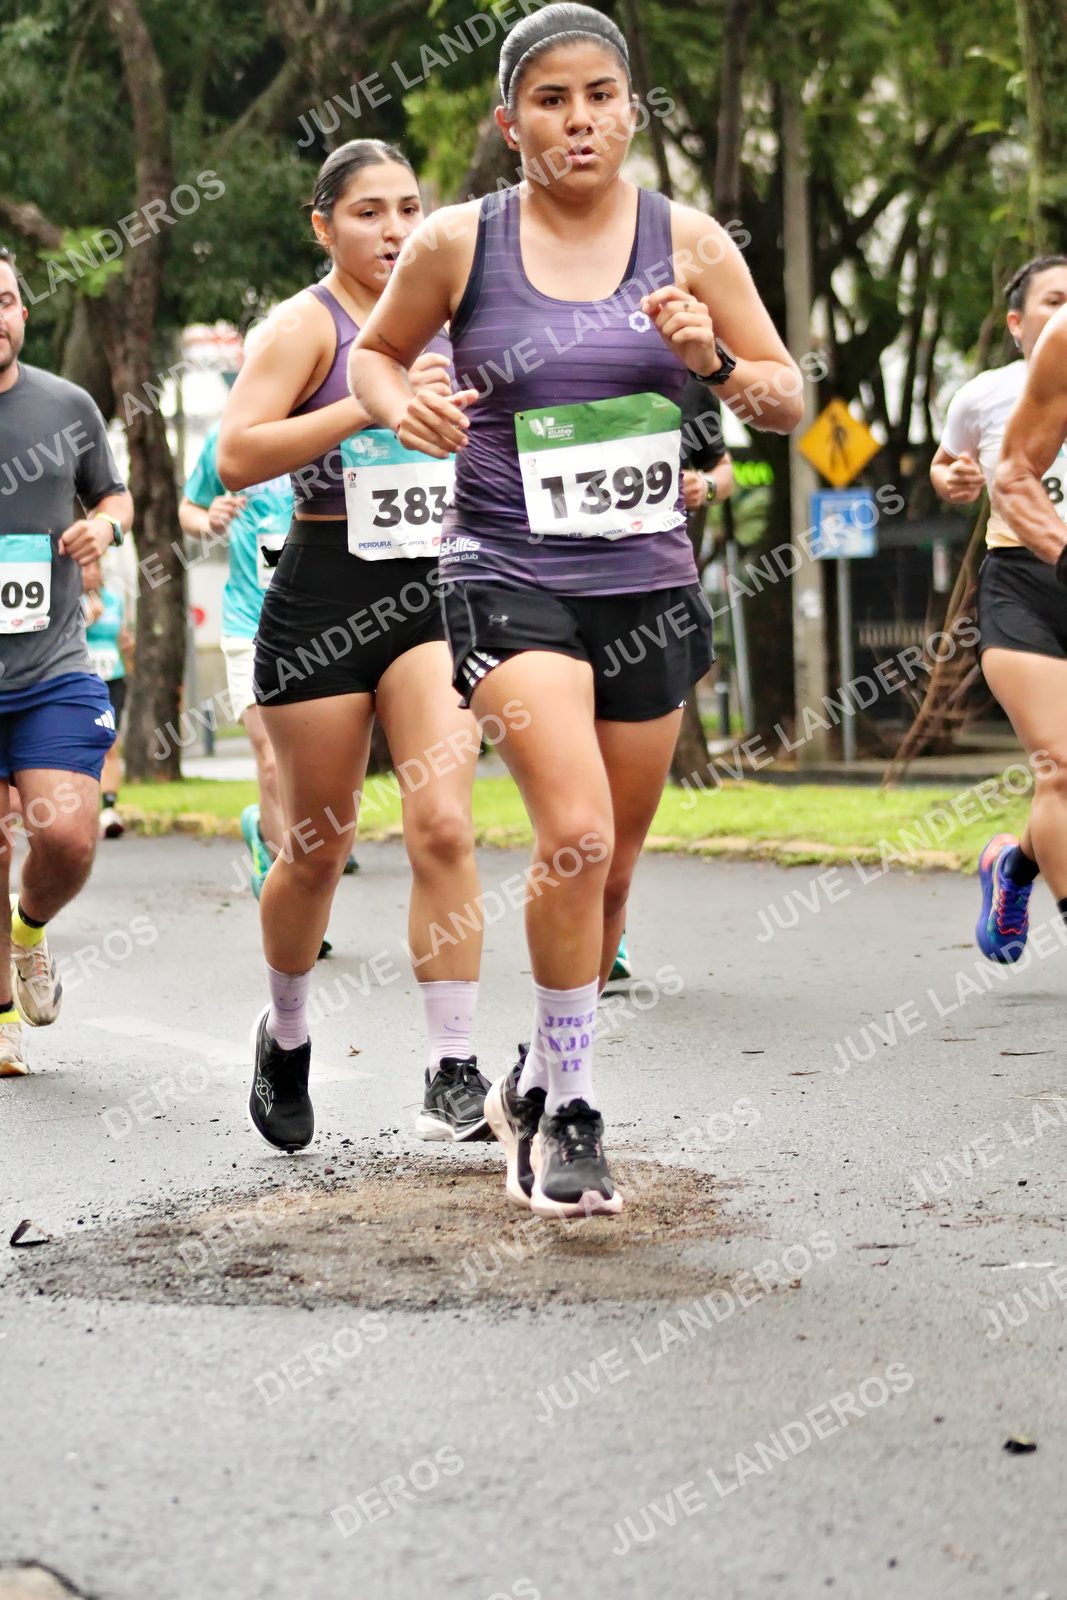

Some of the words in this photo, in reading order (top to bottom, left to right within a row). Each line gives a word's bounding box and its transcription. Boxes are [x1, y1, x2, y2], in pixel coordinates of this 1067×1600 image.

[540, 461, 672, 519] 1399
[662, 517, 681, 528] 1399
[358, 540, 392, 549] PERDURA
[461, 553, 479, 561] club
[1, 581, 45, 609] 09
[545, 1011, 595, 1028] JUST
[561, 1058, 582, 1073] IT
